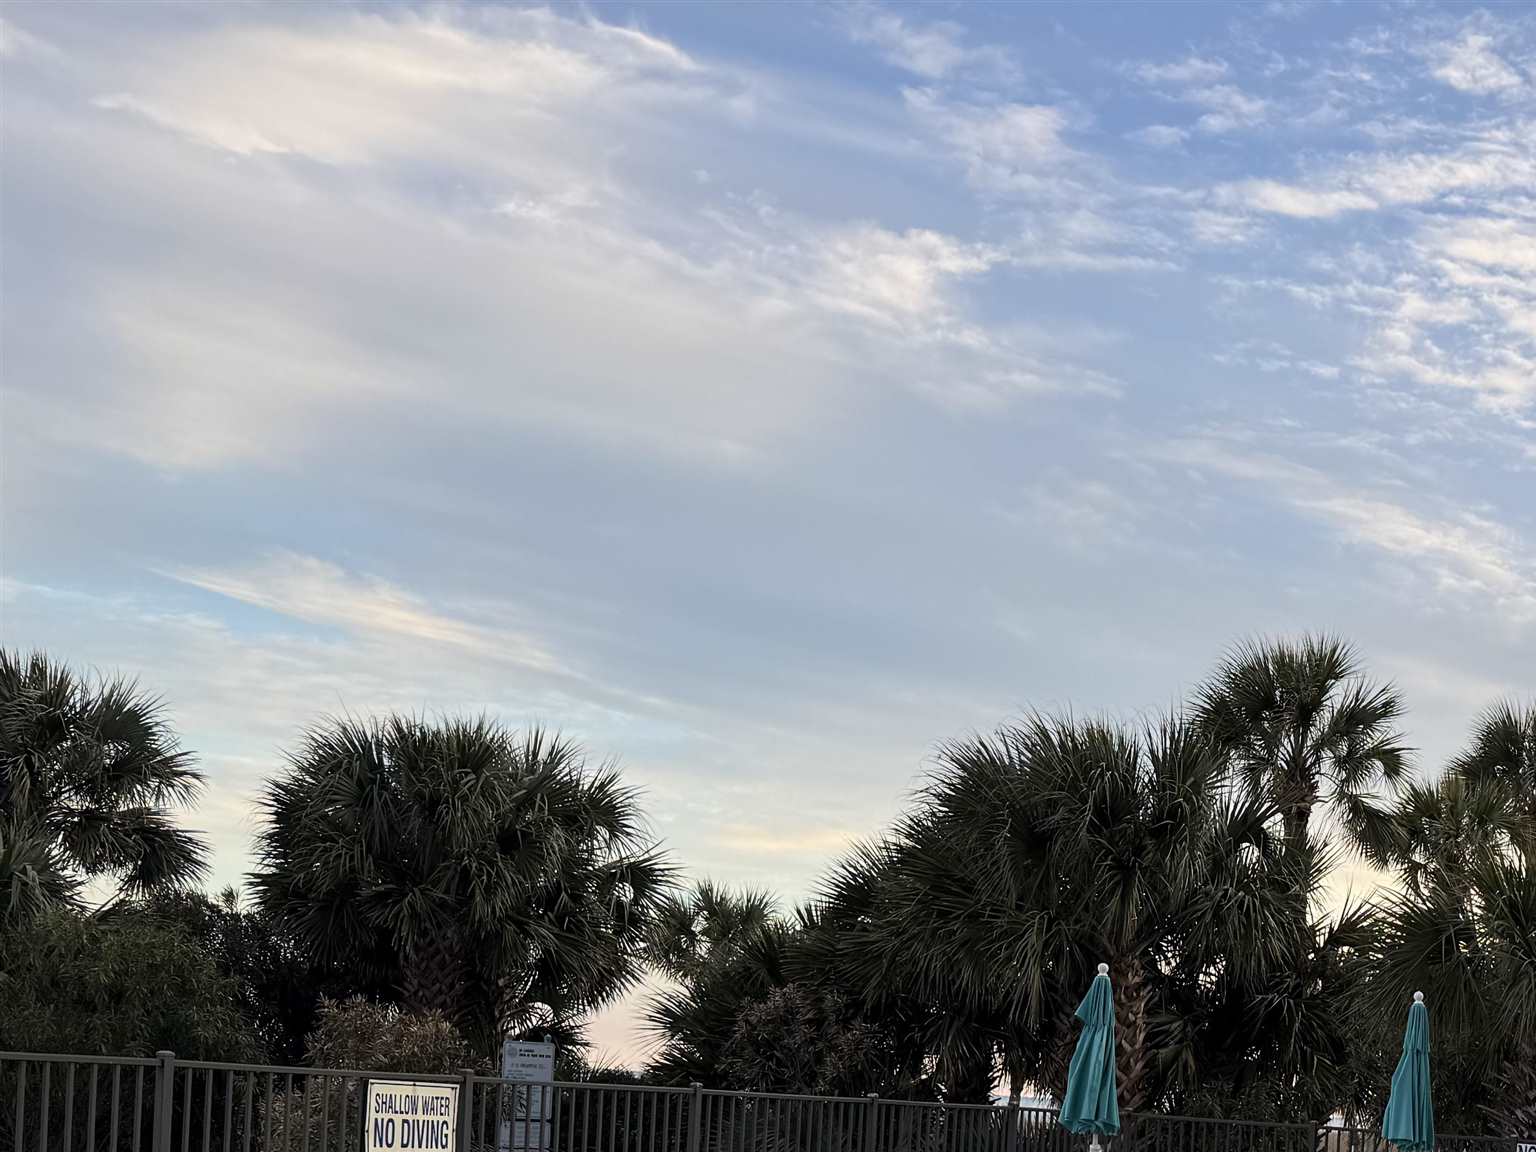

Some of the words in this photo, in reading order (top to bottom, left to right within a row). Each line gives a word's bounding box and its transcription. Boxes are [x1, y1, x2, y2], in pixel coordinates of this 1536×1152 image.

[374, 1093, 419, 1115] SHALLOW
[421, 1095, 450, 1117] WATER
[373, 1117, 395, 1148] NO
[401, 1119, 449, 1149] DIVING
